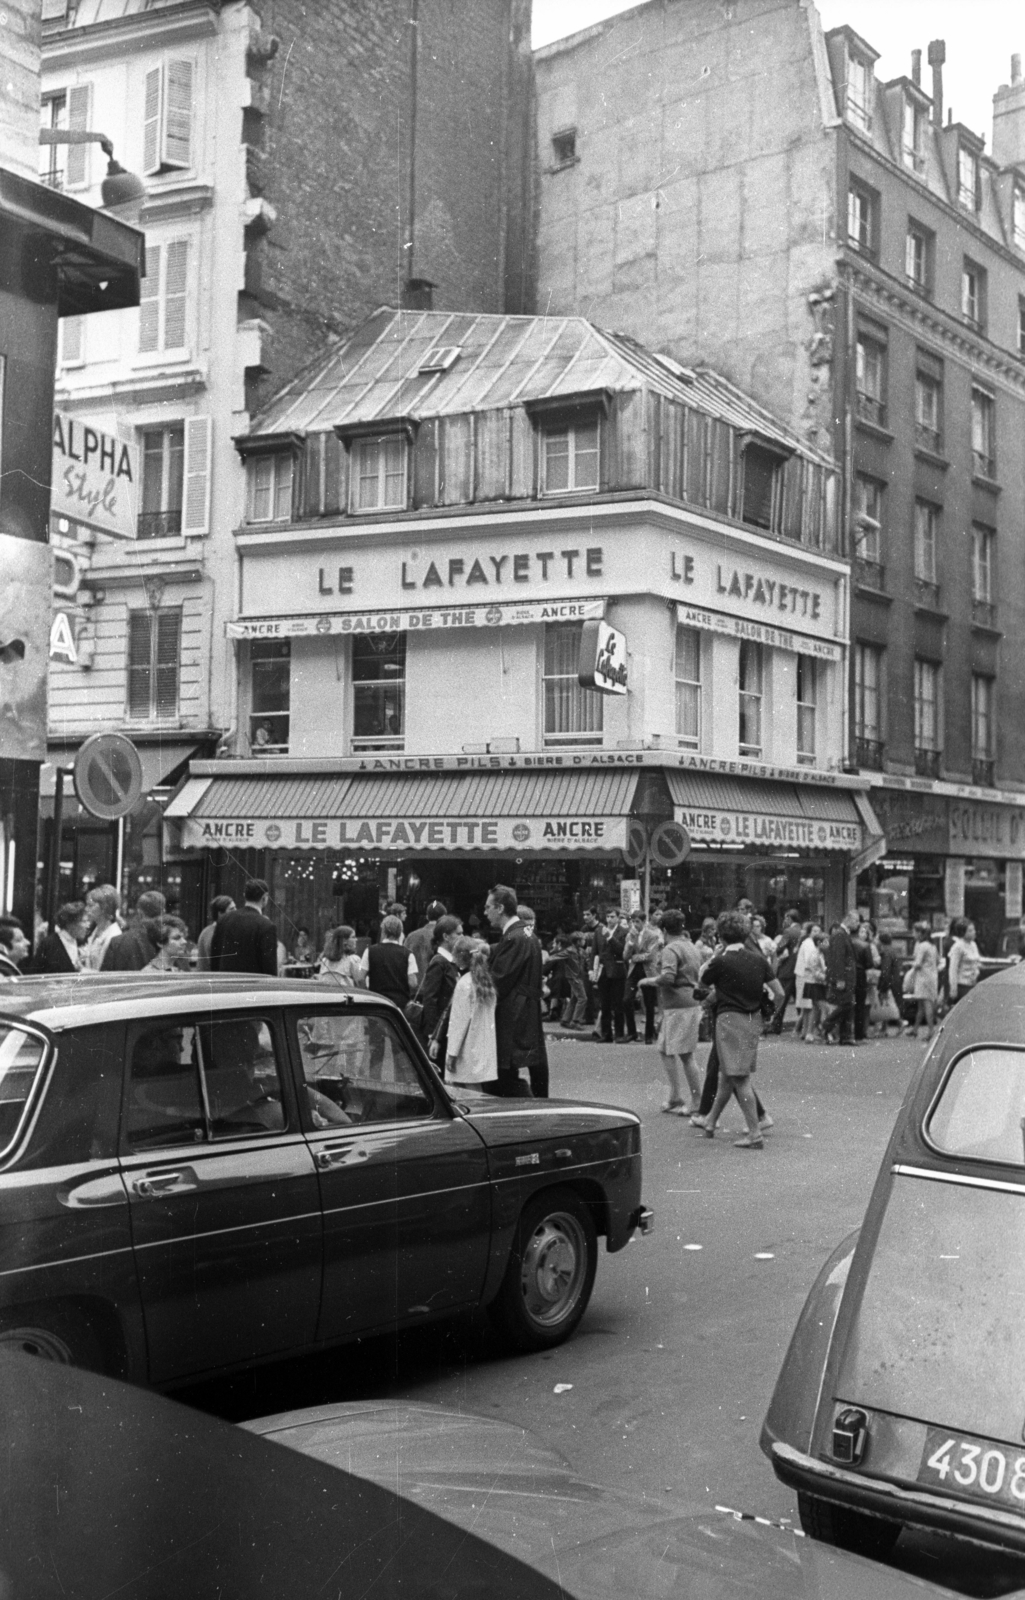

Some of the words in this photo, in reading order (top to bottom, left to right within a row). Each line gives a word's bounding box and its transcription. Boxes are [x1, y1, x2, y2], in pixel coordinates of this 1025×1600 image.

[53, 414, 133, 483] ALPHA
[63, 464, 117, 518] Style
[319, 566, 353, 595] LE
[401, 547, 603, 590] LAFAYETTE
[671, 551, 694, 585] LE
[717, 564, 821, 619] LAFAYETTE
[341, 615, 400, 631] SALON
[409, 613, 432, 628] DE
[440, 611, 476, 625] THE
[541, 604, 585, 618] ANCRE
[685, 610, 711, 626] ANCRE
[241, 623, 281, 635] ANCRE
[734, 620, 762, 640] SALON
[764, 628, 776, 644] DE
[604, 632, 616, 656] Le
[373, 758, 444, 770] ANCRE
[457, 757, 501, 768] PILS
[524, 756, 563, 766] BIERE
[688, 757, 736, 773] ANCRE
[741, 763, 766, 777] PILS
[202, 823, 255, 837] ANCRE
[543, 822, 604, 837] ANCRE
[682, 812, 717, 830] ANCRE
[736, 816, 750, 838] LE
[754, 817, 814, 843] LAFAYETTE
[295, 822, 328, 843] LE
[340, 822, 498, 843] LAFAYETTE
[829, 825, 857, 841] ANCRE
[927, 1439, 1025, 1500] 4308
